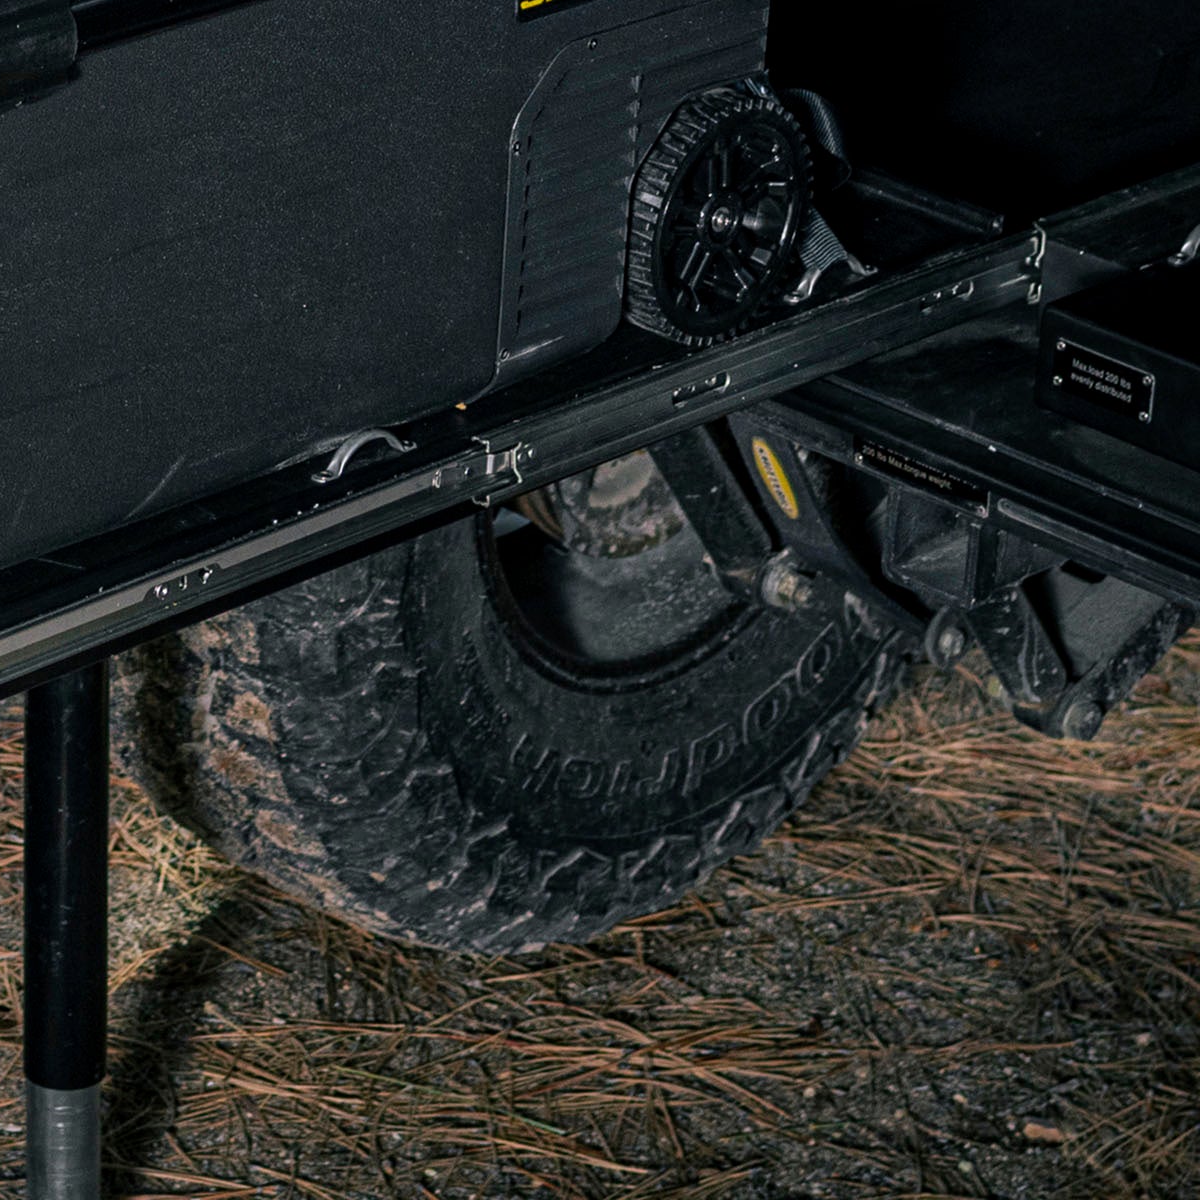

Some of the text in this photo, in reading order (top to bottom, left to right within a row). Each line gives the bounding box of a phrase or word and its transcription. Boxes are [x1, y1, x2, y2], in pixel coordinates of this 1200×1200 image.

[1070, 372, 1132, 404] evenly distributed
[1105, 371, 1119, 385] 200
[1120, 377, 1131, 390] lbs
